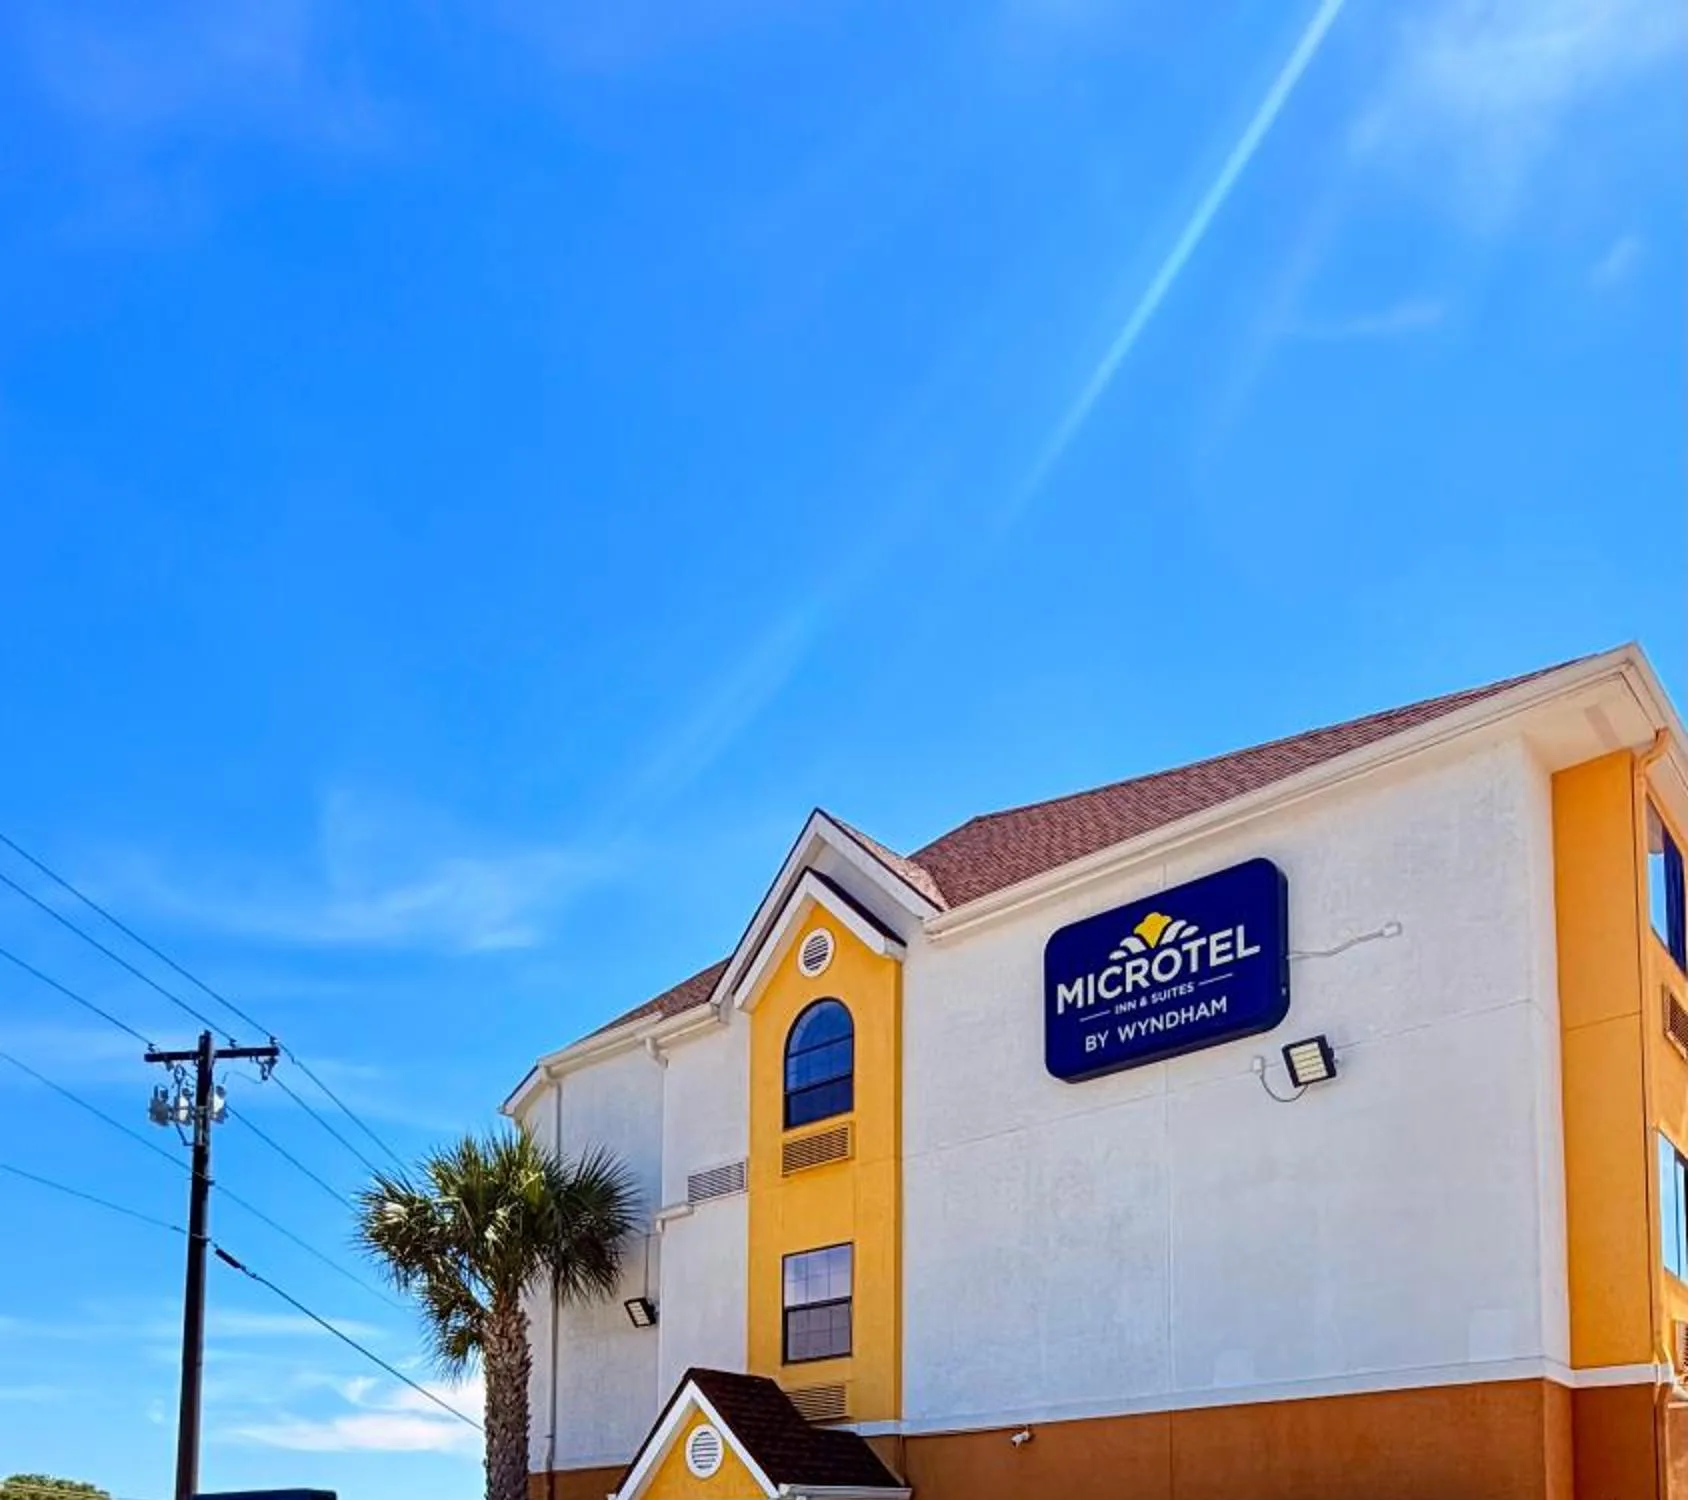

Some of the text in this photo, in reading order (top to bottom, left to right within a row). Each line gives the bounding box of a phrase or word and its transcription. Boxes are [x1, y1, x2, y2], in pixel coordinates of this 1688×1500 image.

[1057, 925, 1260, 1014] MICROTEL
[1085, 996, 1228, 1052] BY WYNDHAM
[1114, 982, 1195, 1015] INN & SUITES
